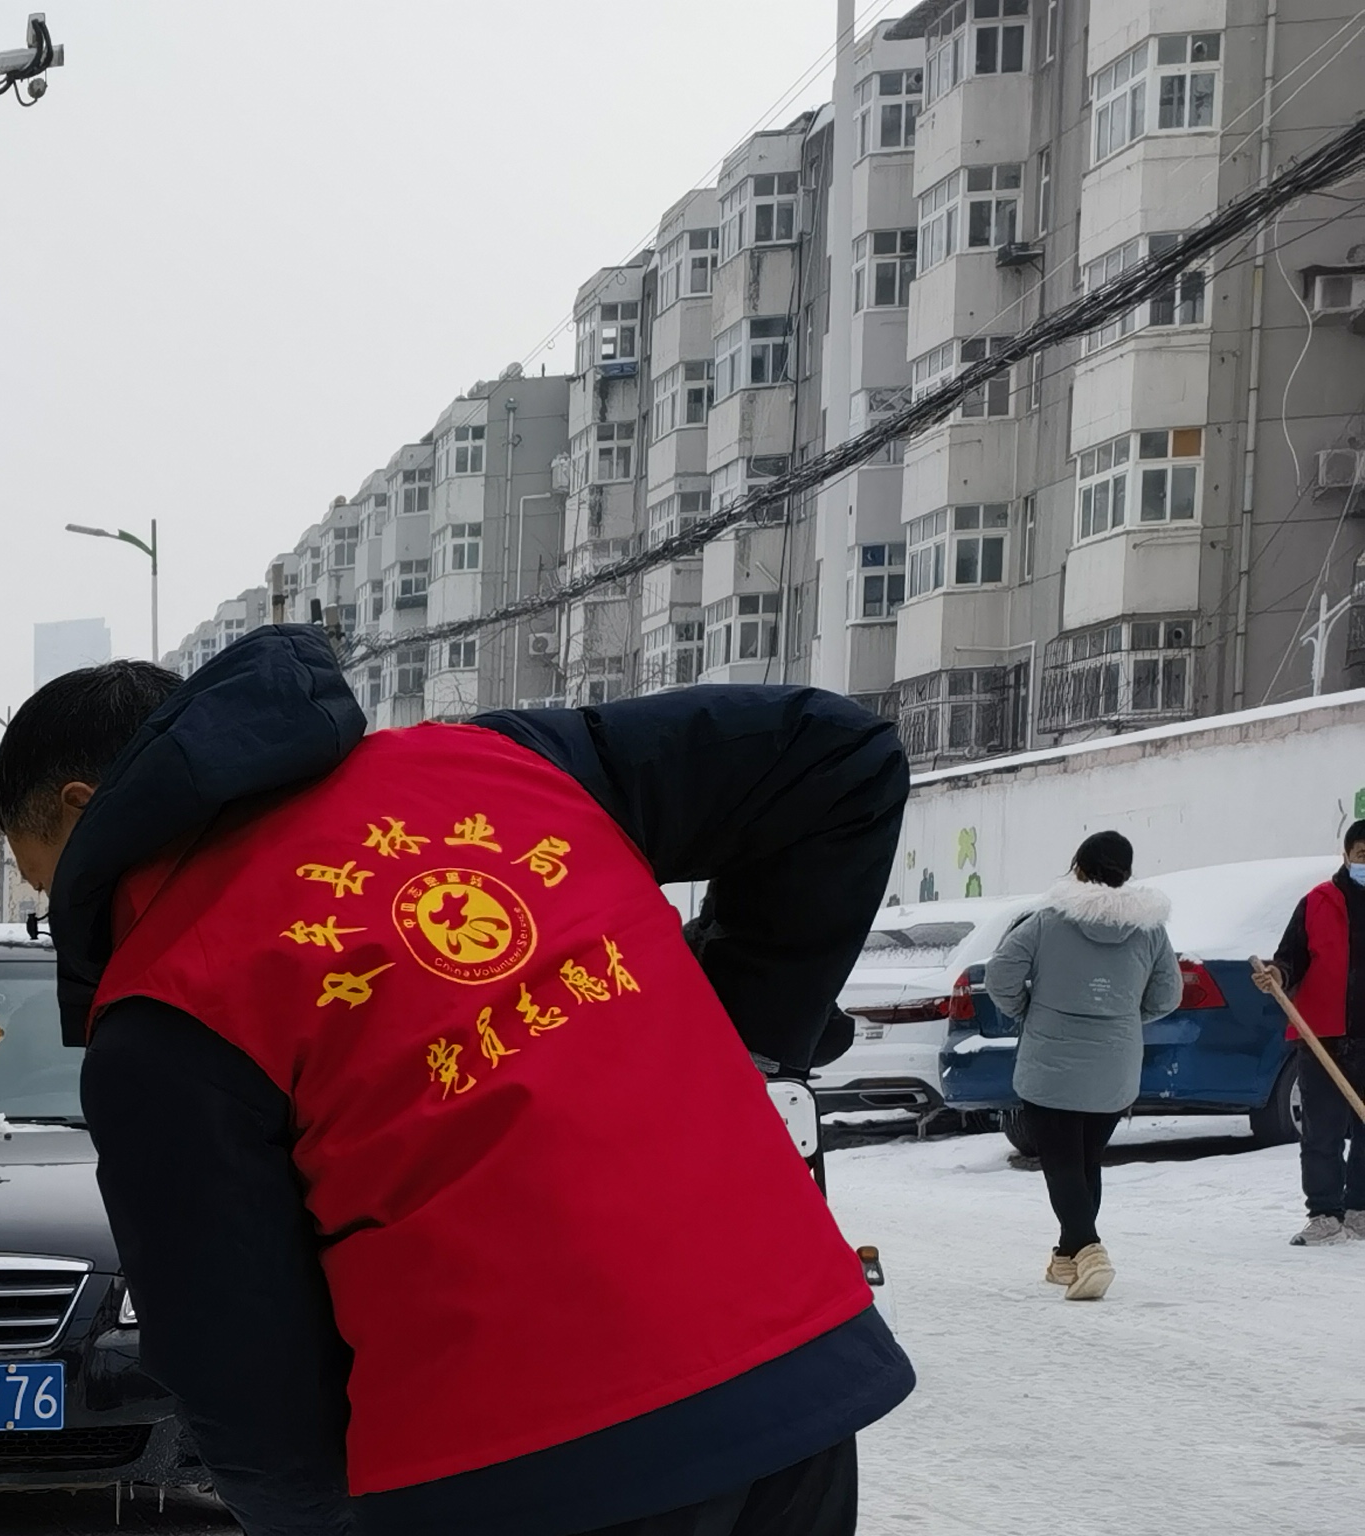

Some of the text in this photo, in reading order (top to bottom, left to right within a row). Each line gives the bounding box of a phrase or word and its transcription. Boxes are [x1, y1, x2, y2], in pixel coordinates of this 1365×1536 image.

[426, 935, 641, 1100] 党员志愿者
